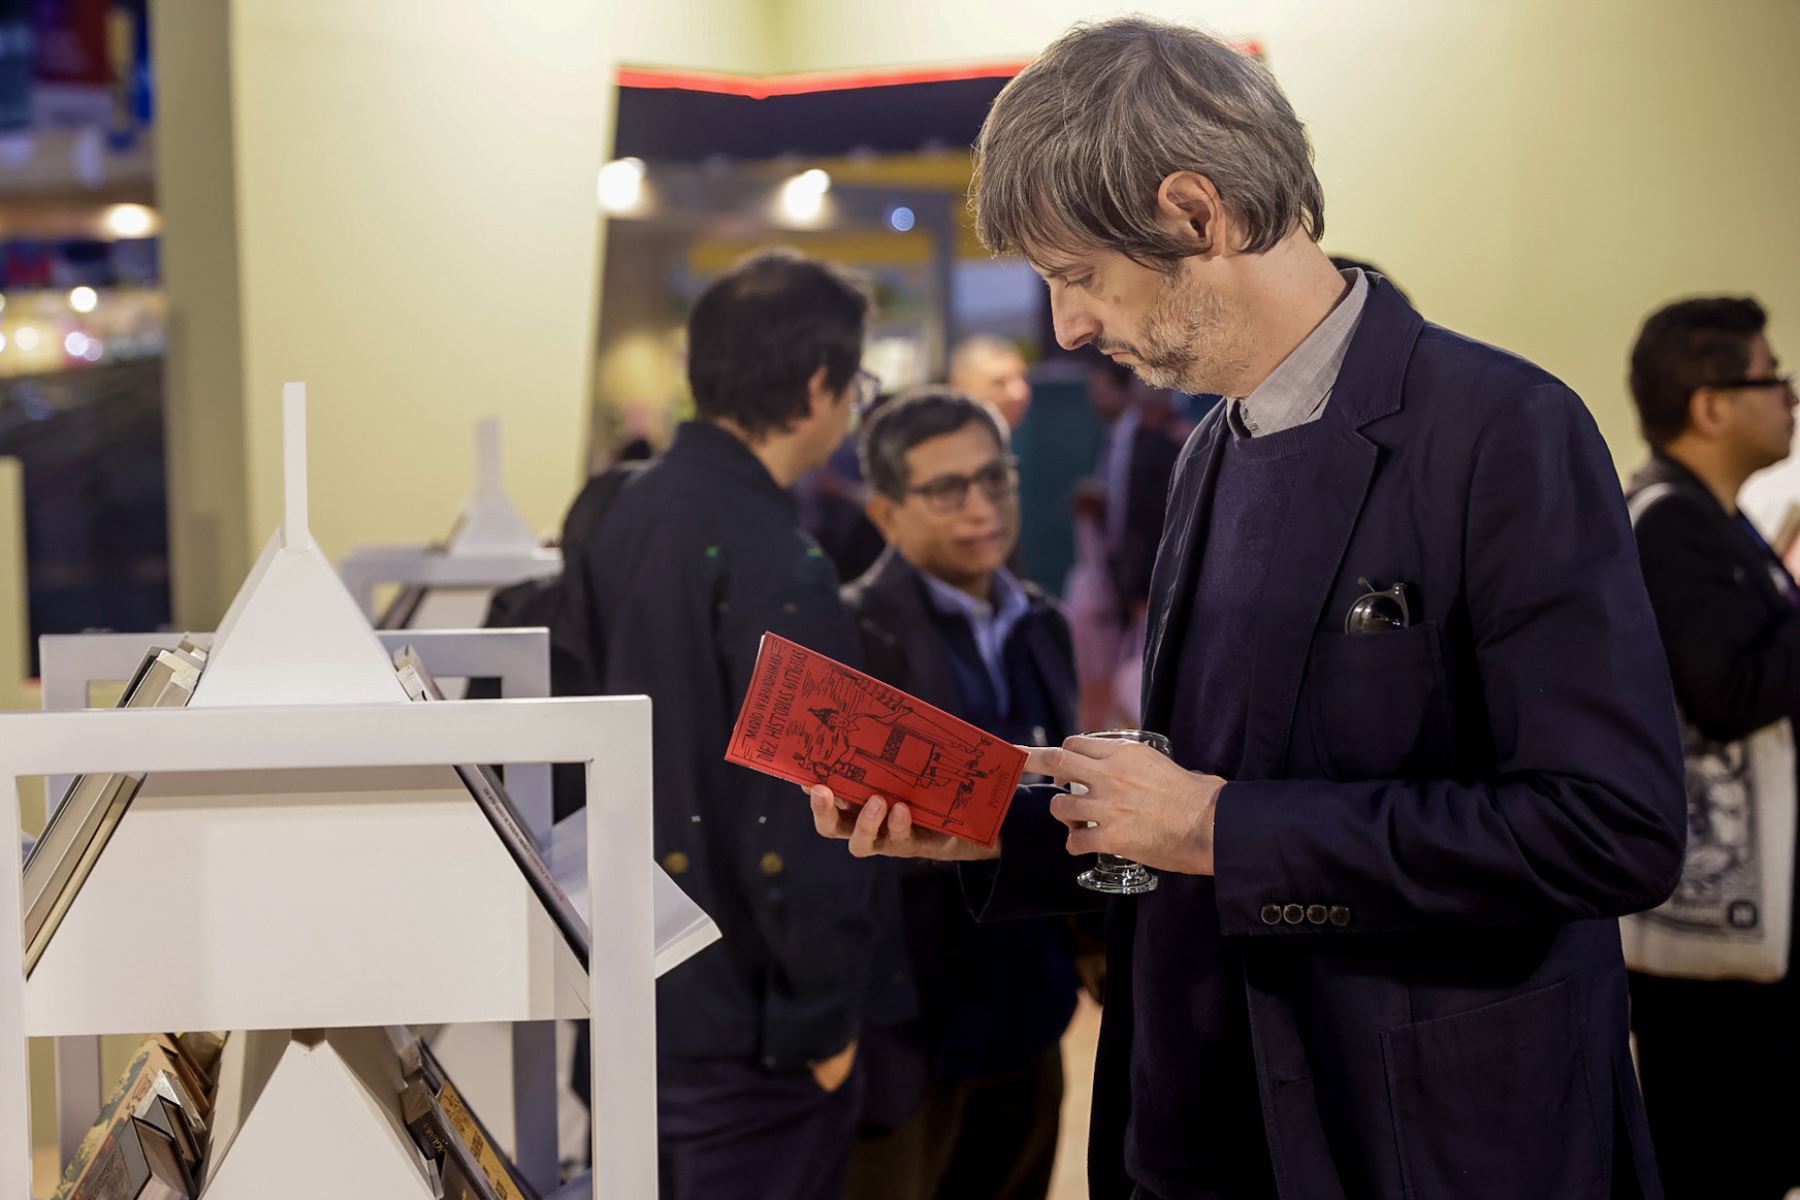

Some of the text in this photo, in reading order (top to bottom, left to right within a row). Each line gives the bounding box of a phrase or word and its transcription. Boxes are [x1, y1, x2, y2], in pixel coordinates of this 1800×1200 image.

[745, 711, 764, 740] MARIO
[764, 689, 796, 741] HISTORIAS
[755, 739, 779, 763] DIEZ
